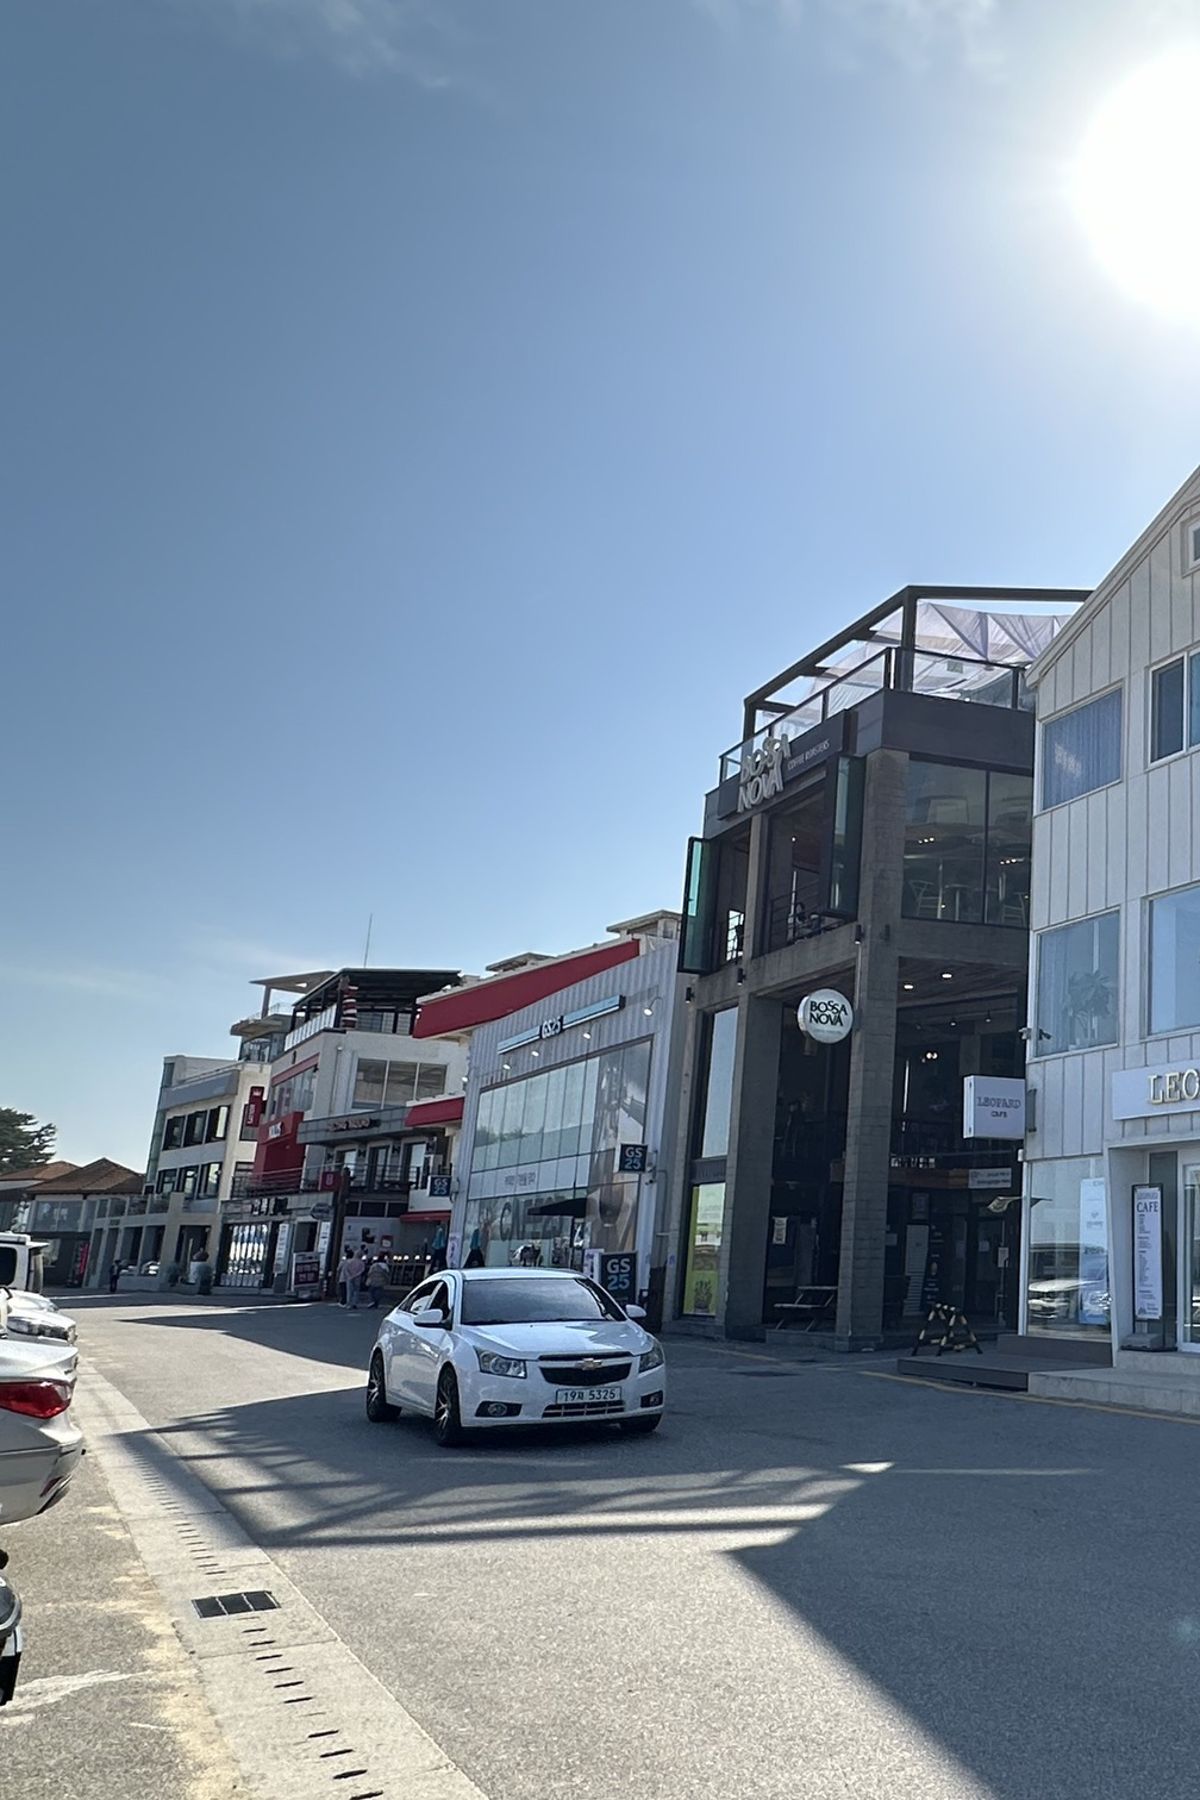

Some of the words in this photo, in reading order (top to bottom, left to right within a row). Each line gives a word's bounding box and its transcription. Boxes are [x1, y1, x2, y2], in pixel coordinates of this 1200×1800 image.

[737, 752, 783, 813] NOVA
[810, 1000, 848, 1016] BOSSA
[810, 1011, 843, 1027] NOVA
[976, 1096, 1021, 1109] LEOPARD
[624, 1146, 643, 1158] GS
[623, 1158, 641, 1170] 25
[433, 1178, 448, 1187] GS
[1136, 1200, 1159, 1213] CAFE
[606, 1258, 631, 1274] GS
[607, 1274, 630, 1291] 25
[588, 1388, 616, 1401] 5325
